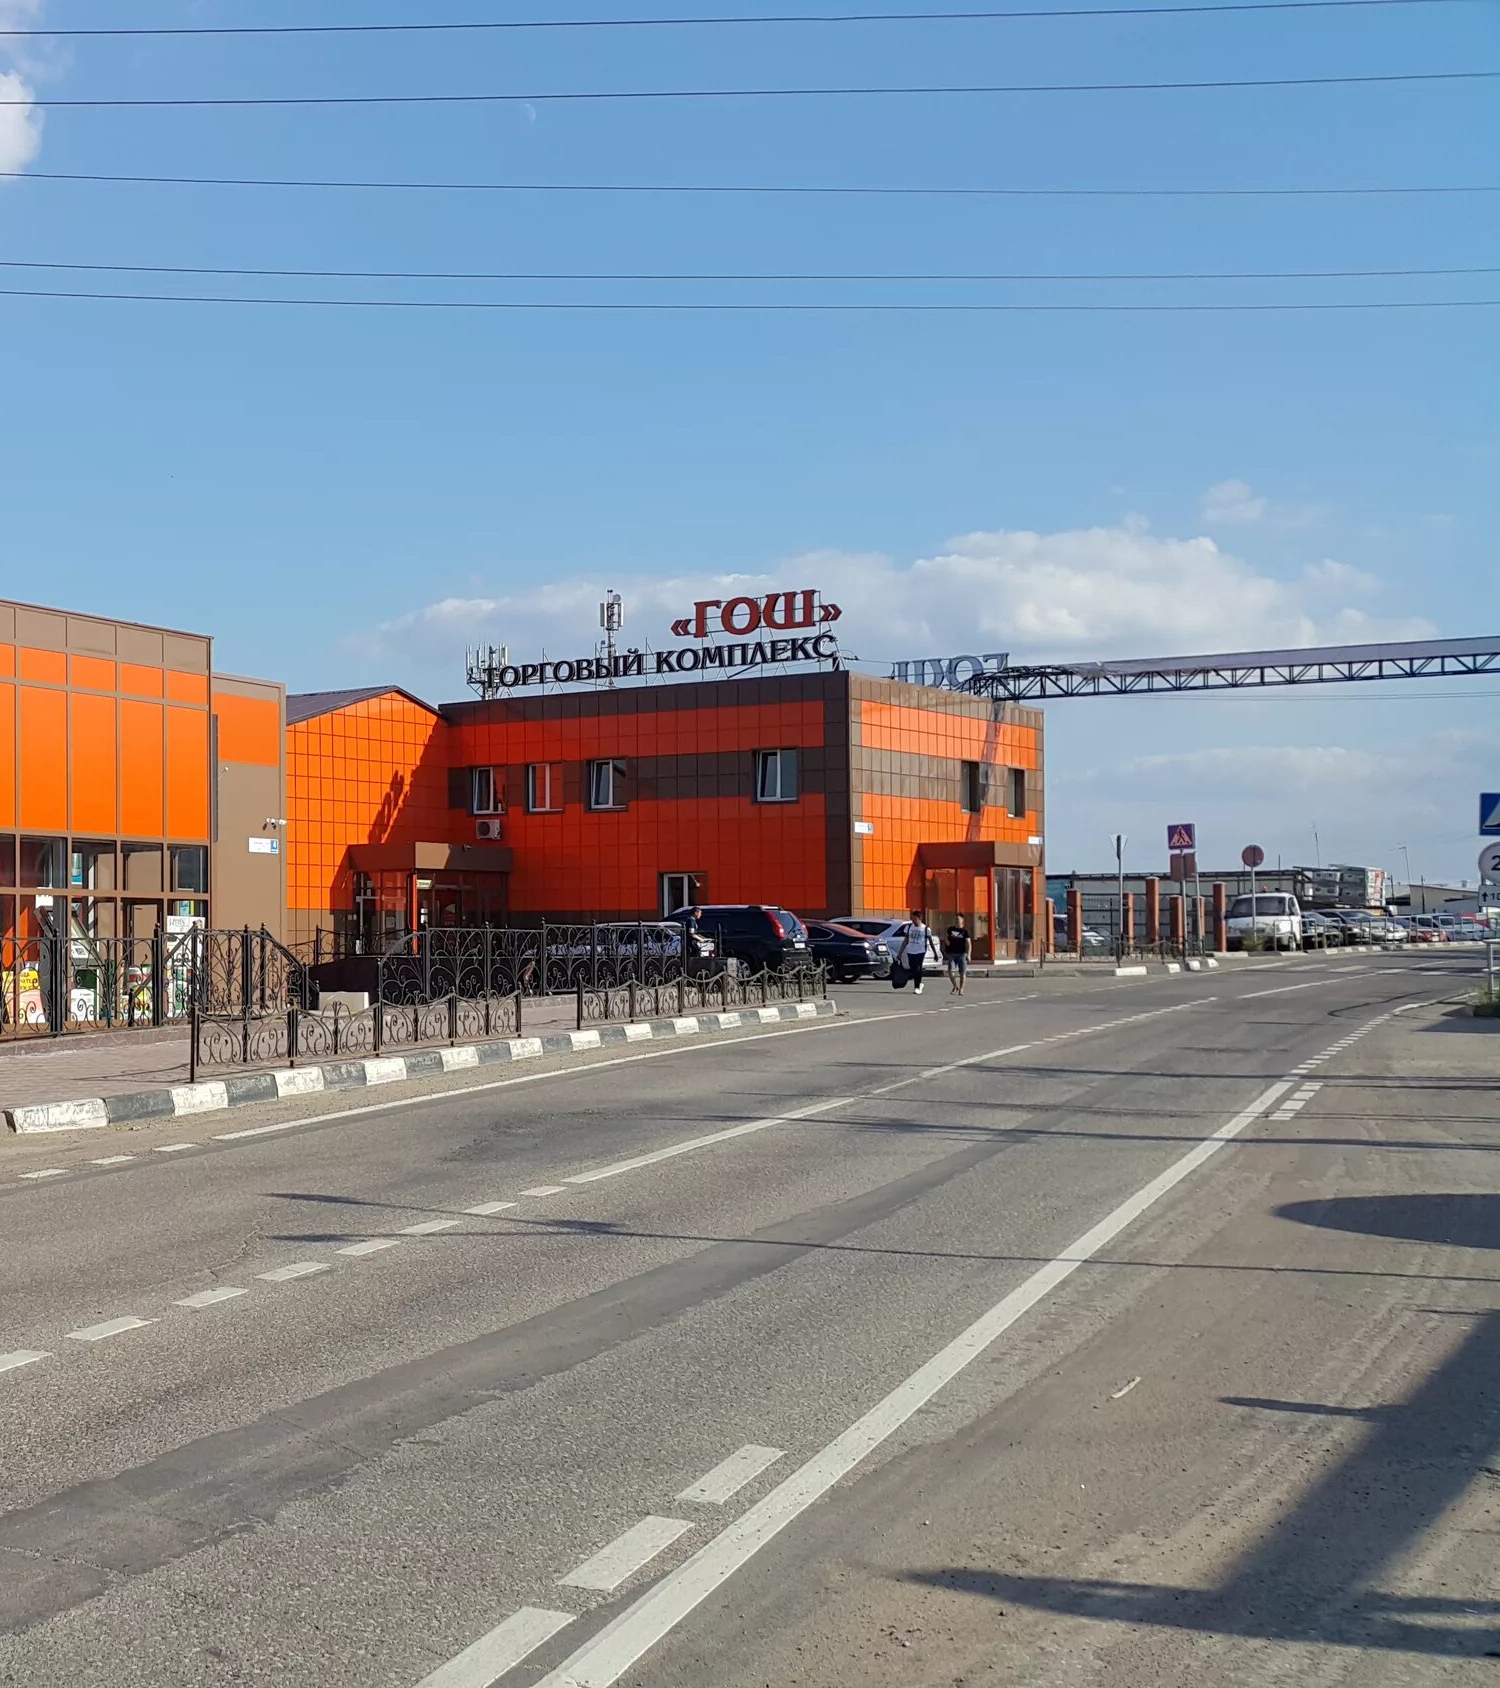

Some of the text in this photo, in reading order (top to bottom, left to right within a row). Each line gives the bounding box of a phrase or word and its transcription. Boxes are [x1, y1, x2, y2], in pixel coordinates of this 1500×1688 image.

[670, 589, 843, 639] «ГОШ»
[483, 634, 837, 688] ТОРГОВЫЙ КОМПЛЕКС
